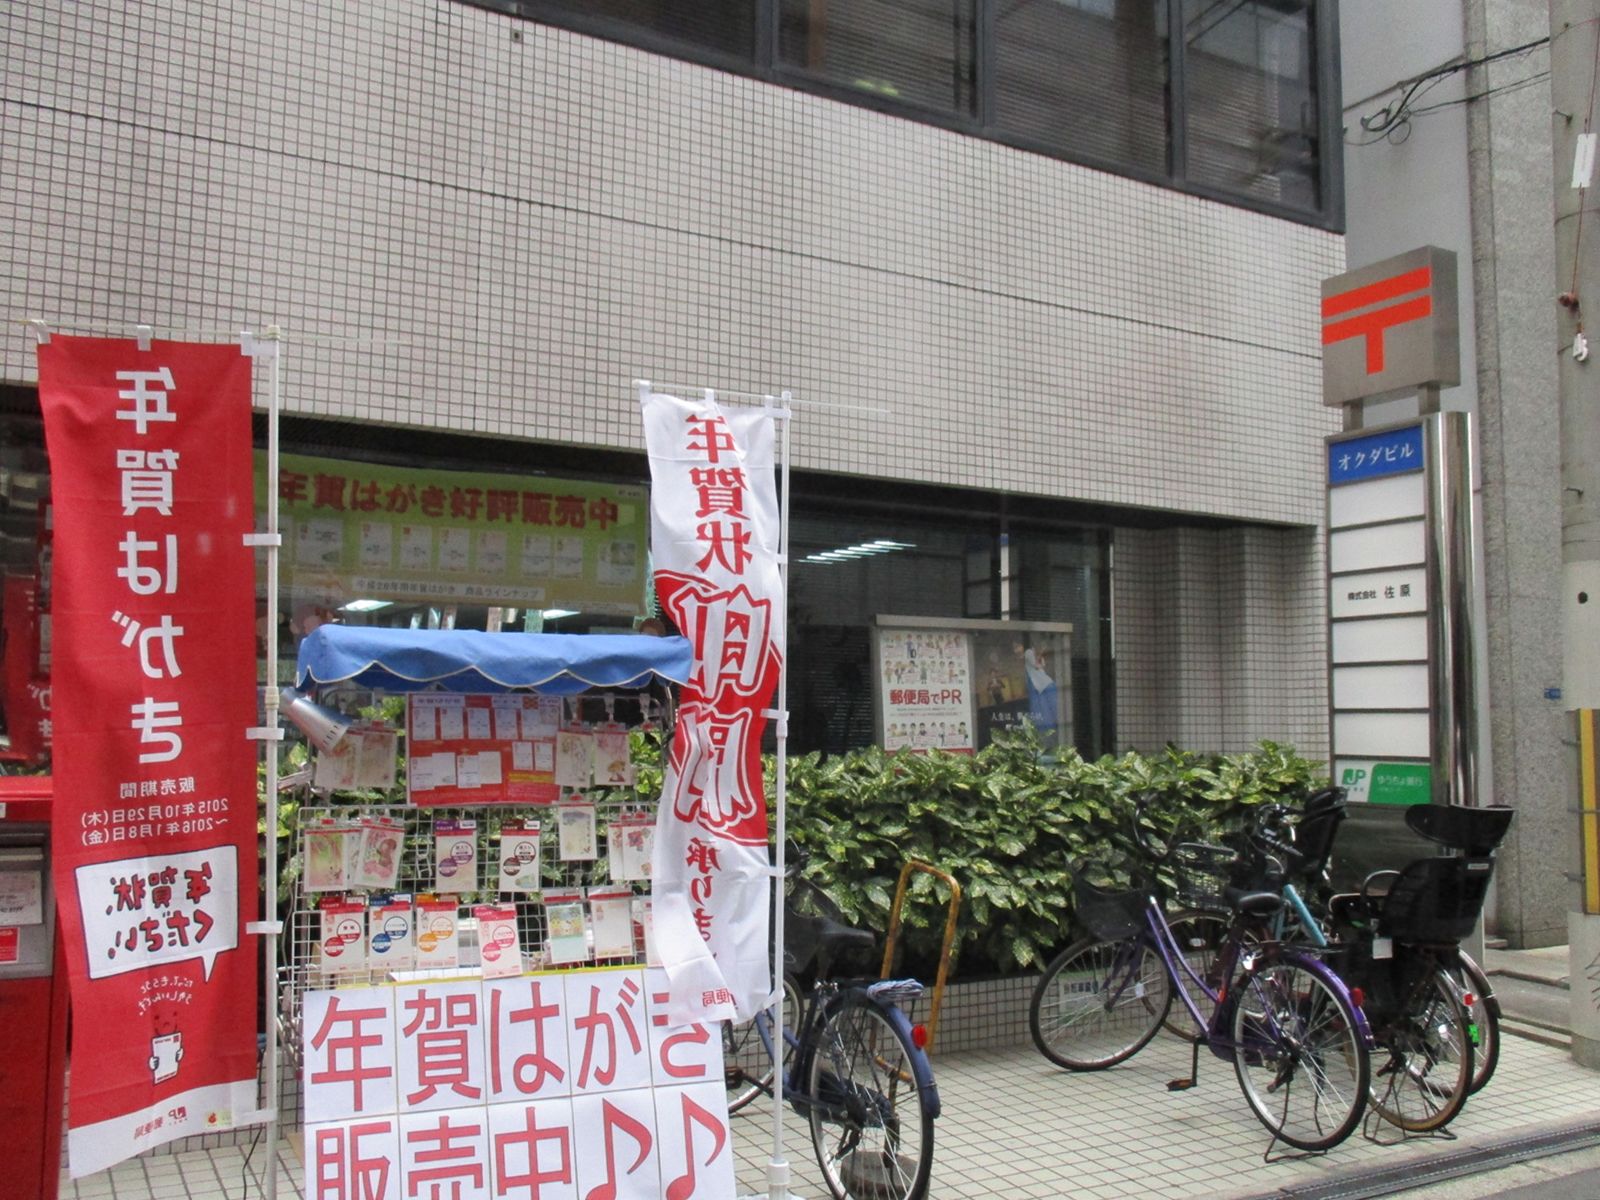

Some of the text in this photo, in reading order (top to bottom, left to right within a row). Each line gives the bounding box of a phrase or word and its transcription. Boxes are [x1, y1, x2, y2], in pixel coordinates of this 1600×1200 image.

[1337, 443, 1415, 472] オクダビル
[278, 468, 619, 531] 年賀はがき好評販売中
[889, 689, 963, 705] 郵便局でPR
[1342, 768, 1367, 785] JP
[311, 976, 711, 1112] 年賀はがき
